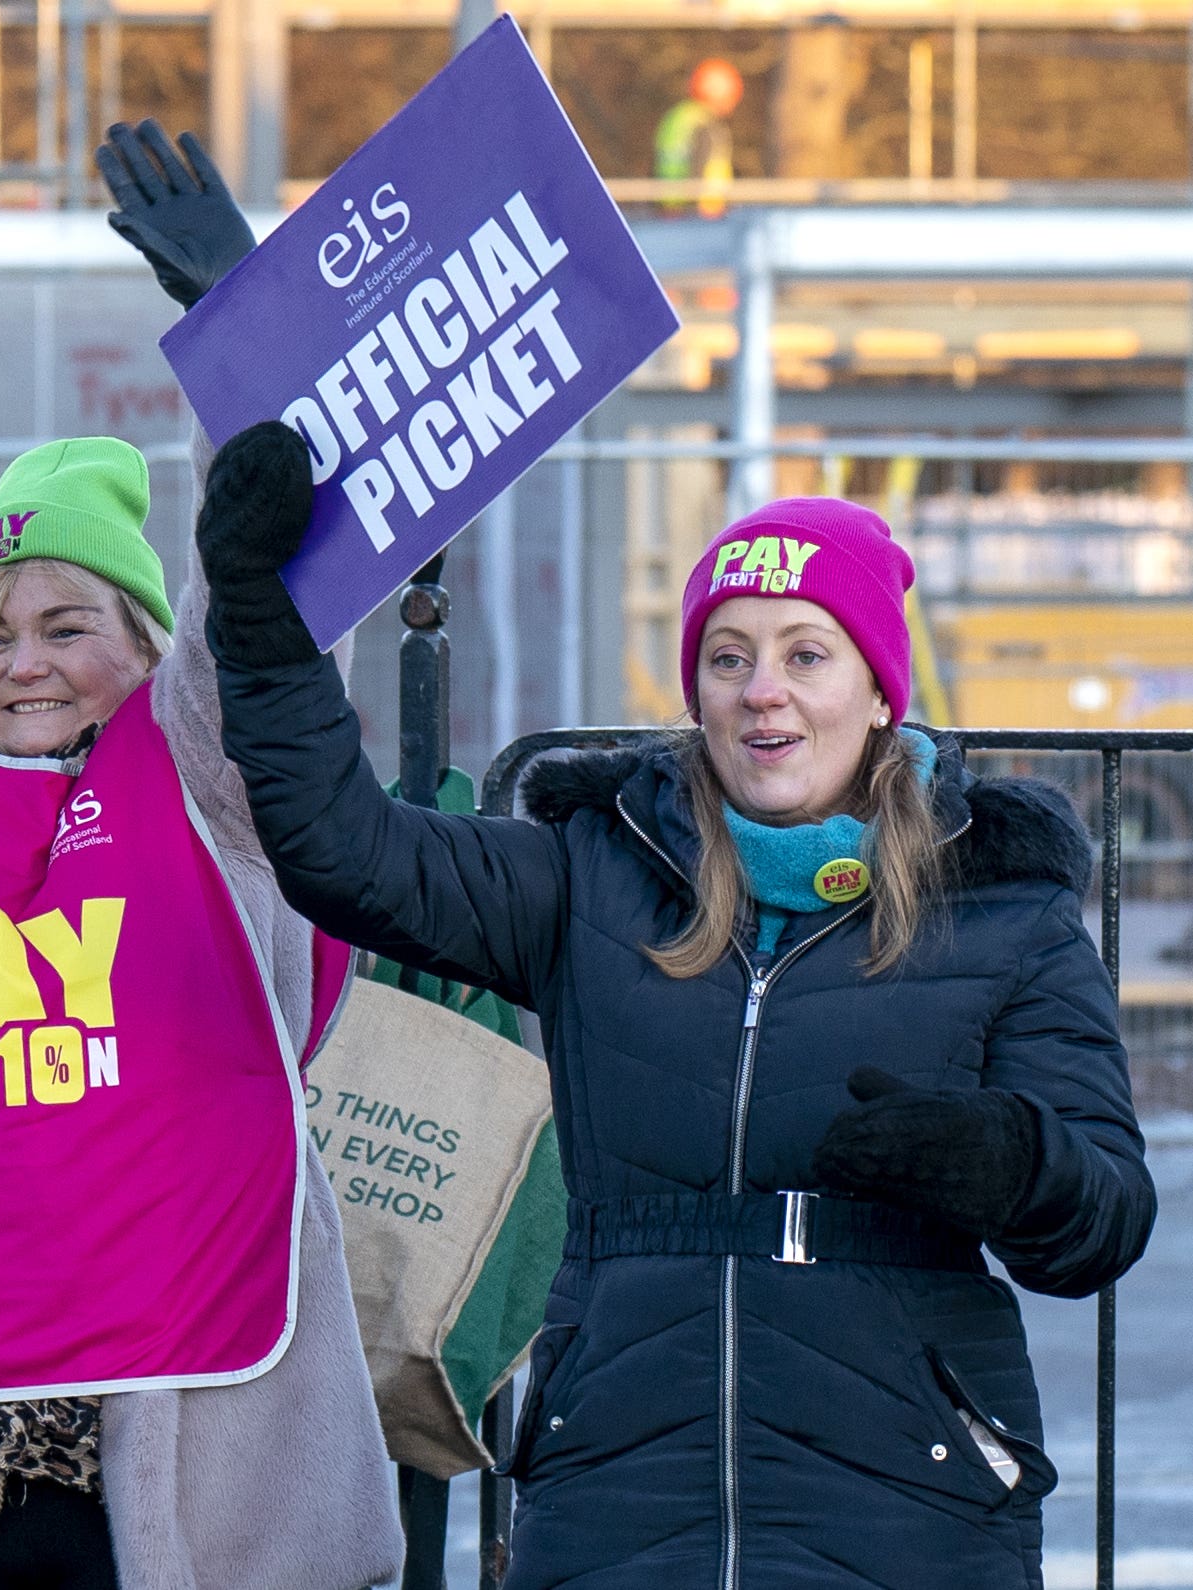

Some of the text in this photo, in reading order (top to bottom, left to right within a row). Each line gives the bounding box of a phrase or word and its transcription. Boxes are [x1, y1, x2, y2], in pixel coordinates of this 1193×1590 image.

[318, 182, 410, 288] eis
[345, 236, 418, 308] The Educational
[345, 241, 433, 329] Institute of Scotland
[279, 190, 569, 486] OFFICIAL
[341, 287, 582, 554] PICKET
[712, 535, 821, 581] PAY
[72, 833, 113, 851] Scotland
[822, 868, 861, 890] PAY
[336, 1091, 461, 1154] THINGS
[341, 1135, 456, 1191] EVERY
[344, 1176, 444, 1224] SHOP
